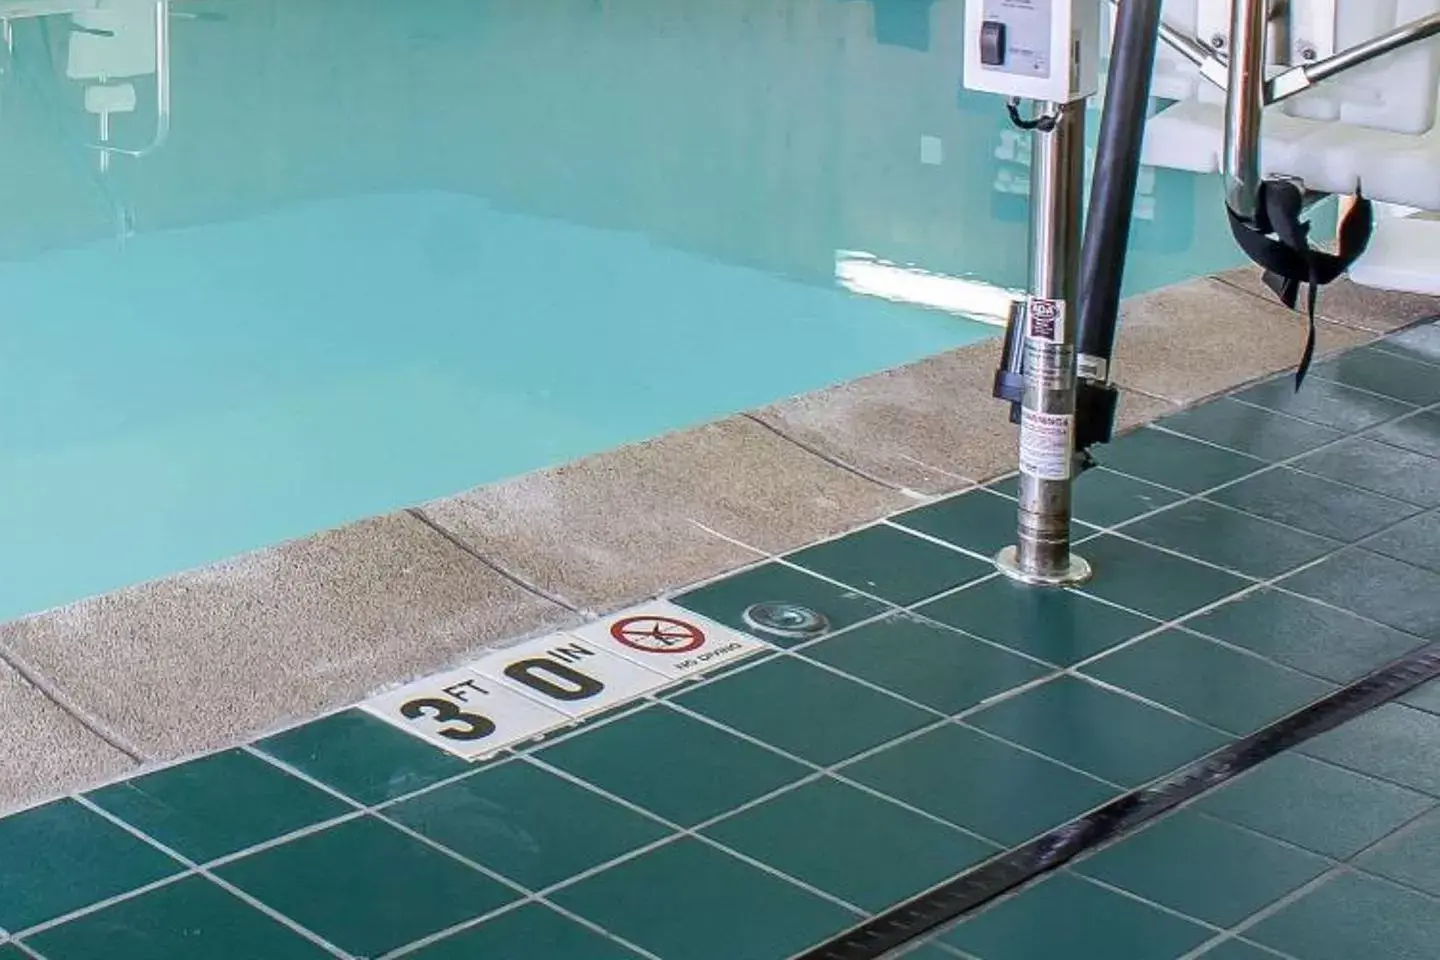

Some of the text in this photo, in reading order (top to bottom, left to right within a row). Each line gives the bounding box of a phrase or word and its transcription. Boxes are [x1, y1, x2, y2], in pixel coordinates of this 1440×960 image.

[697, 642, 743, 661] DIVING
[400, 643, 606, 741] 3 FT 0 IN
